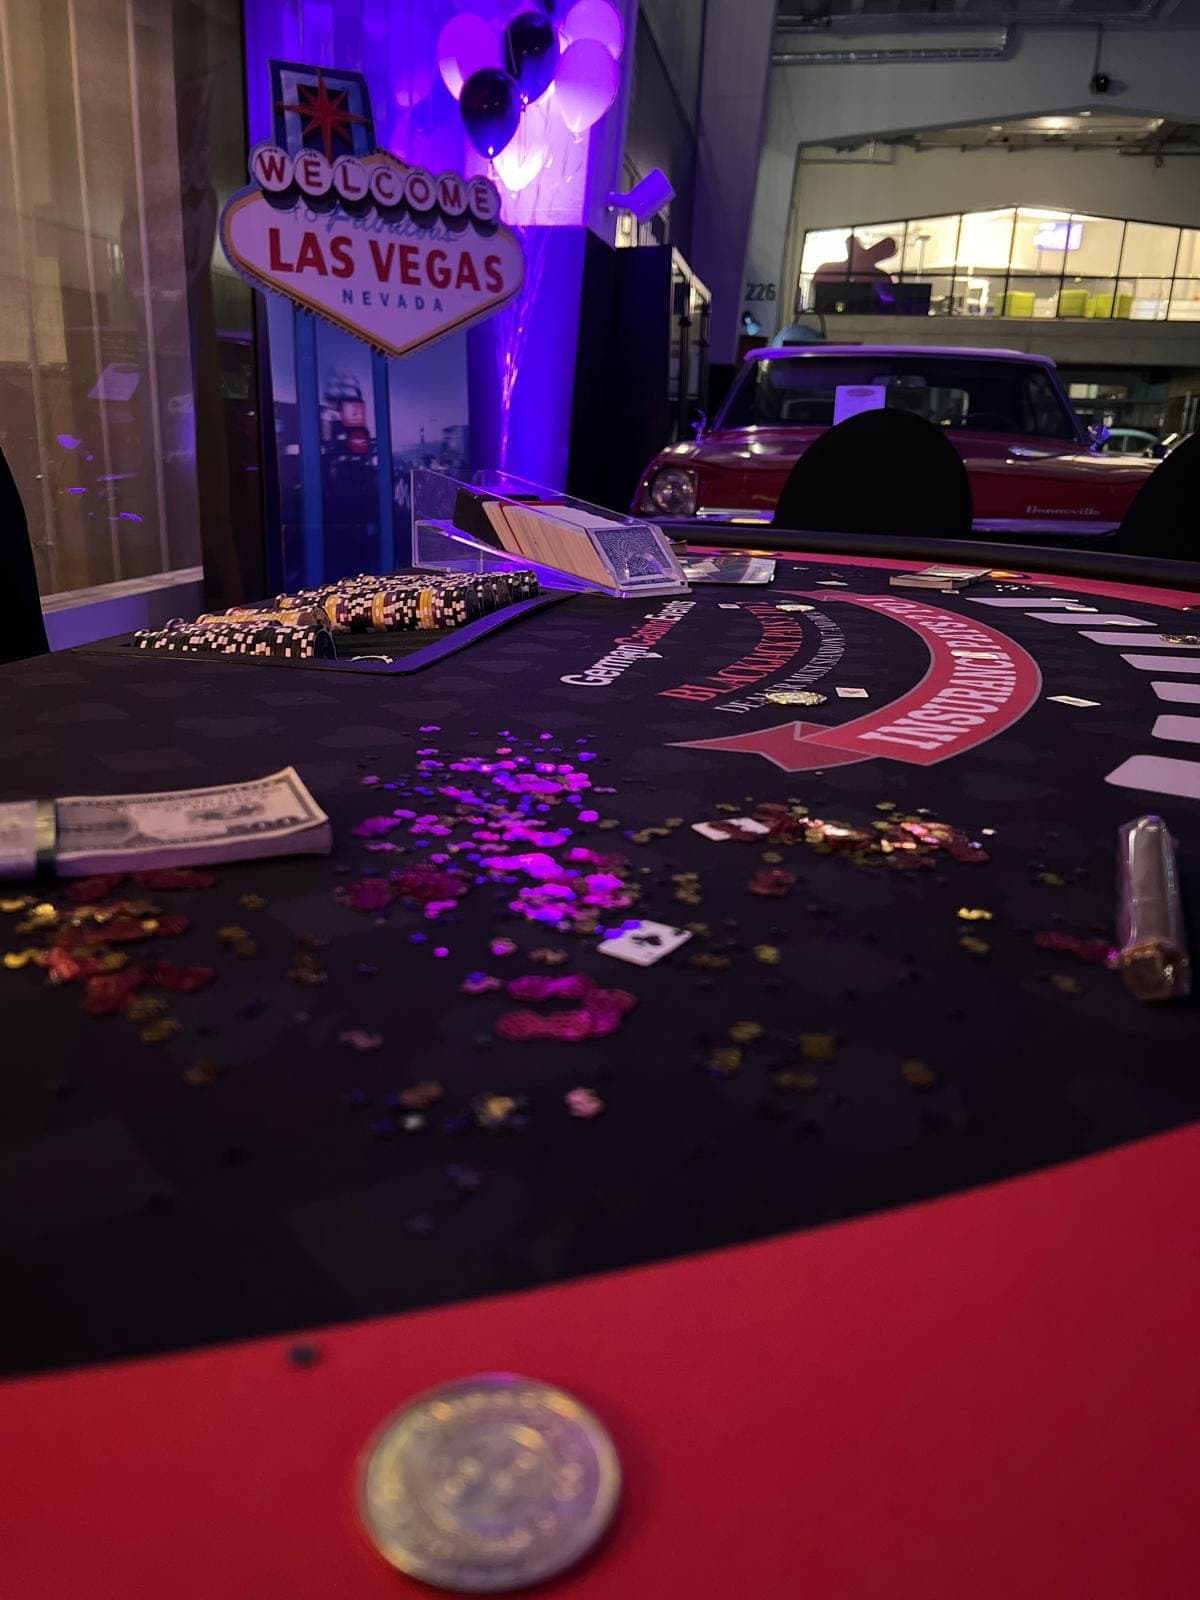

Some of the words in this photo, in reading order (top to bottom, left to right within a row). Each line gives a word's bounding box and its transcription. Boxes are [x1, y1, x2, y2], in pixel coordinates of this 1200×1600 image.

[256, 152, 491, 214] WELCOME
[268, 227, 356, 279] LAS
[368, 239, 505, 293] VEGAS
[342, 289, 444, 313] NEVADA
[745, 283, 777, 301] 226
[918, 620, 1003, 650] PAYS
[655, 638, 803, 702] BLACKJACK
[784, 664, 832, 684] MUST
